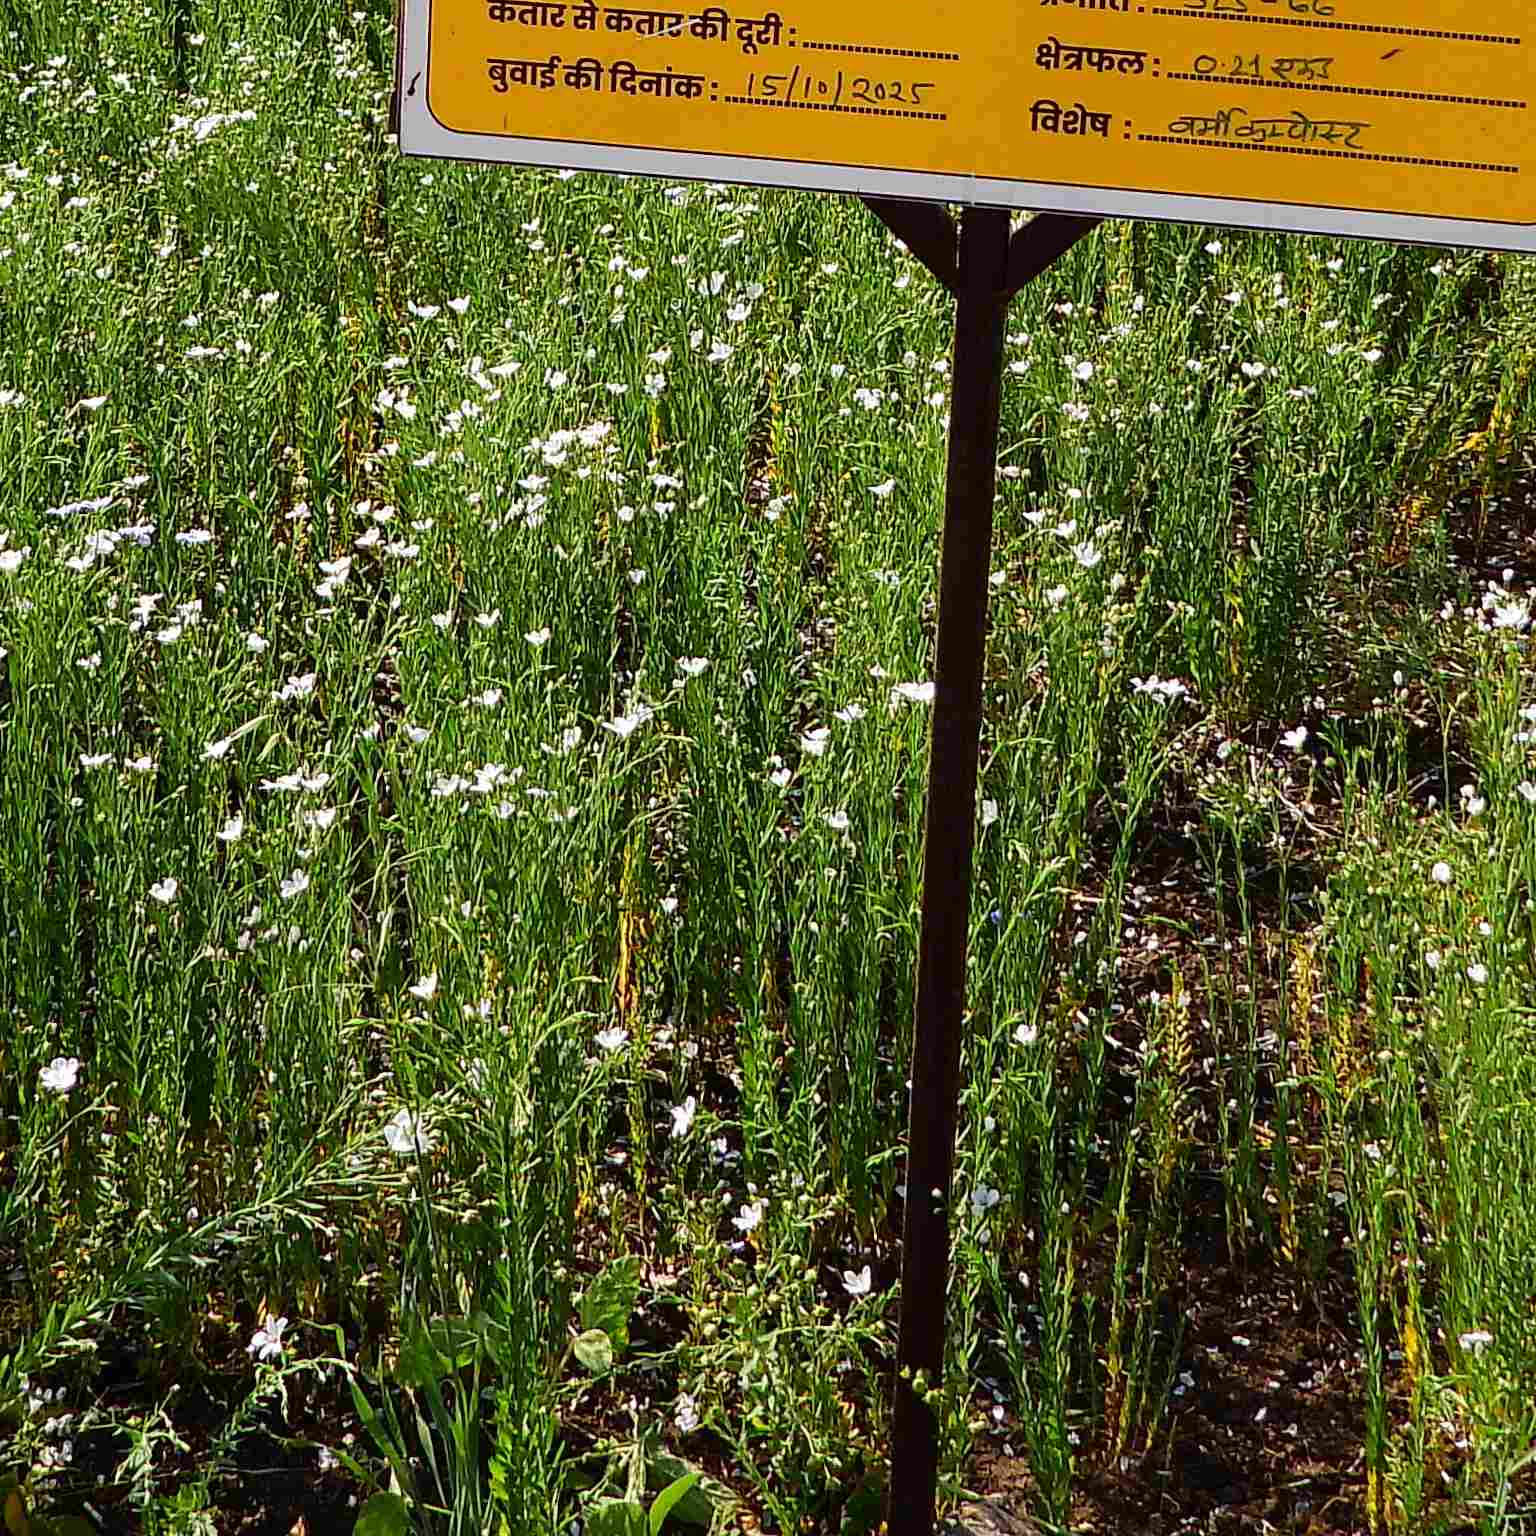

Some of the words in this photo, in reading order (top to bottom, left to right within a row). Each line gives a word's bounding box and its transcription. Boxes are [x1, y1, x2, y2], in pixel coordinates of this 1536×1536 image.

[603, 7, 685, 38] कतार
[688, 7, 731, 42] की
[486, 55, 562, 93] बुवाई
[562, 57, 605, 91] की
[748, 65, 935, 105] 15/10/2025
[1029, 99, 1113, 138] विशेष
